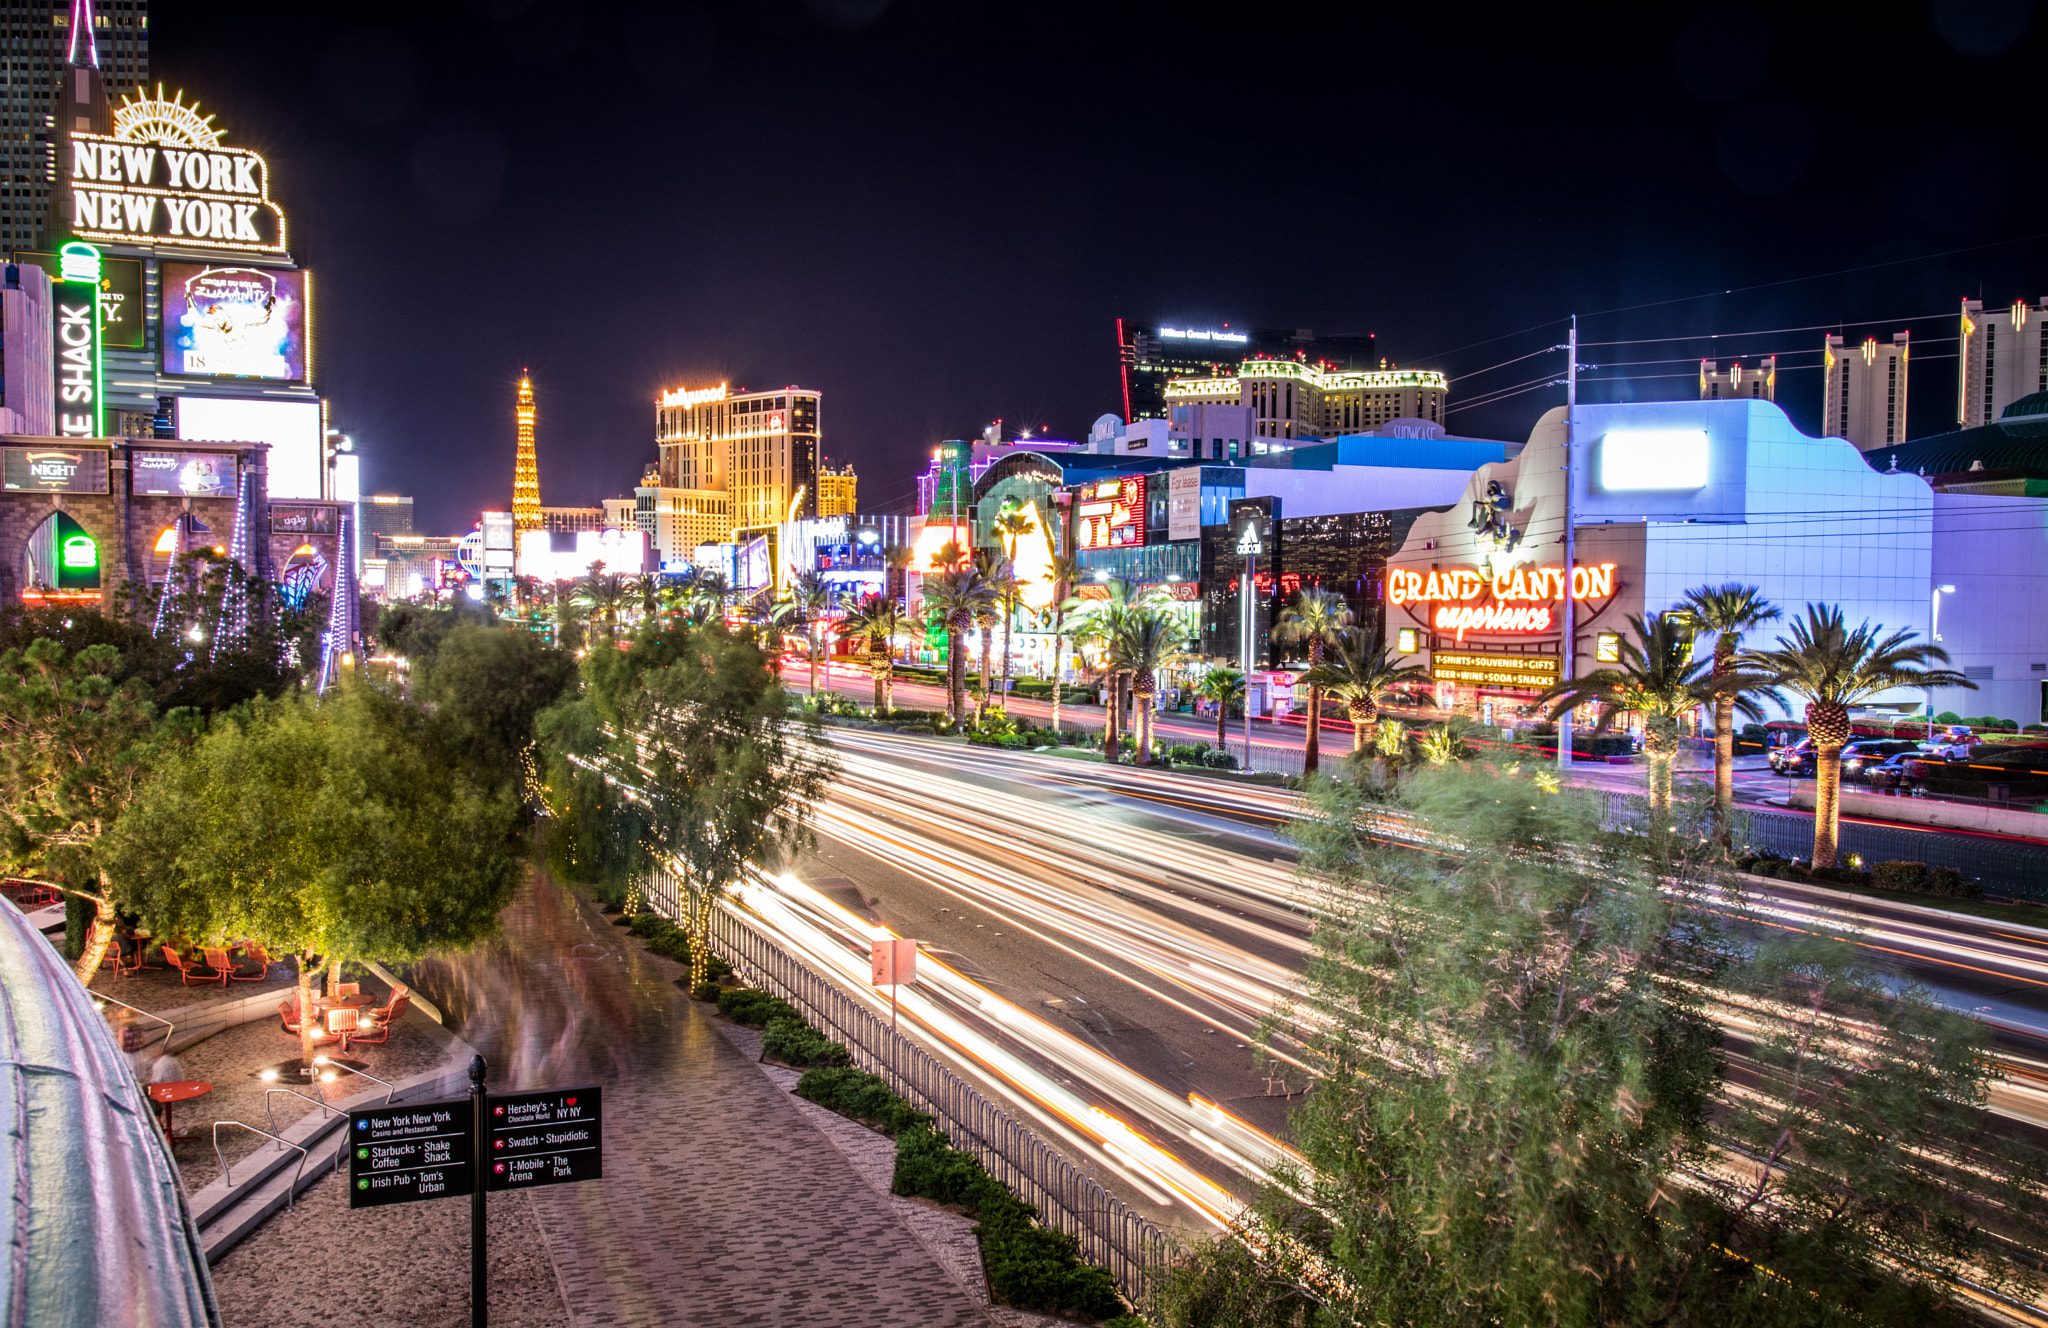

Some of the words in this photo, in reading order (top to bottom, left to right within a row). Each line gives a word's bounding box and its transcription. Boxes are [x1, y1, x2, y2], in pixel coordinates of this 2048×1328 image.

[72, 140, 156, 185] NEW
[162, 149, 260, 195] YORK
[72, 189, 157, 233] NEW
[162, 197, 261, 241] YORK
[194, 286, 270, 304] ZUMANITY
[61, 303, 92, 403] SHACK
[663, 382, 727, 410] hollywood
[31, 464, 77, 476] NIGHT
[283, 515, 307, 525] ugly
[1388, 568, 1482, 605] GRAND
[1491, 563, 1615, 601] CANYON
[1435, 600, 1550, 643] experience
[1434, 655, 1472, 665] T-SHIRTS
[1475, 657, 1524, 668] SOUVENIRS
[1528, 660, 1555, 670] GIFTS
[1434, 669, 1456, 679] BEER
[1460, 671, 1484, 681] WINE
[1488, 673, 1513, 683] SODA
[1517, 675, 1554, 686] SNACKS
[507, 1101, 547, 1115] Hershey's
[556, 1108, 569, 1119] NY
[569, 1106, 581, 1117] NY
[371, 1118, 391, 1129] New
[391, 1115, 411, 1127] York
[412, 1113, 432, 1125] New
[432, 1110, 451, 1123] York
[507, 1114, 534, 1123] Chocolate
[534, 1112, 551, 1120] World
[371, 1129, 392, 1138] Casino
[392, 1127, 404, 1135] and
[404, 1125, 438, 1134] Restaurants
[508, 1134, 539, 1148] Swatch
[545, 1129, 589, 1144] Stupidiotic
[371, 1143, 416, 1158] Starbucks
[423, 1140, 451, 1153] Shake
[371, 1157, 400, 1169] Coffee
[423, 1150, 451, 1163] Shack
[508, 1158, 544, 1172] T-Mobile
[552, 1156, 568, 1167] The
[371, 1175, 392, 1189] Irish
[393, 1174, 411, 1186] Pub
[418, 1170, 444, 1183] Tom's
[508, 1171, 533, 1183] Arena
[553, 1165, 572, 1177] Park
[418, 1182, 445, 1194] Urban
